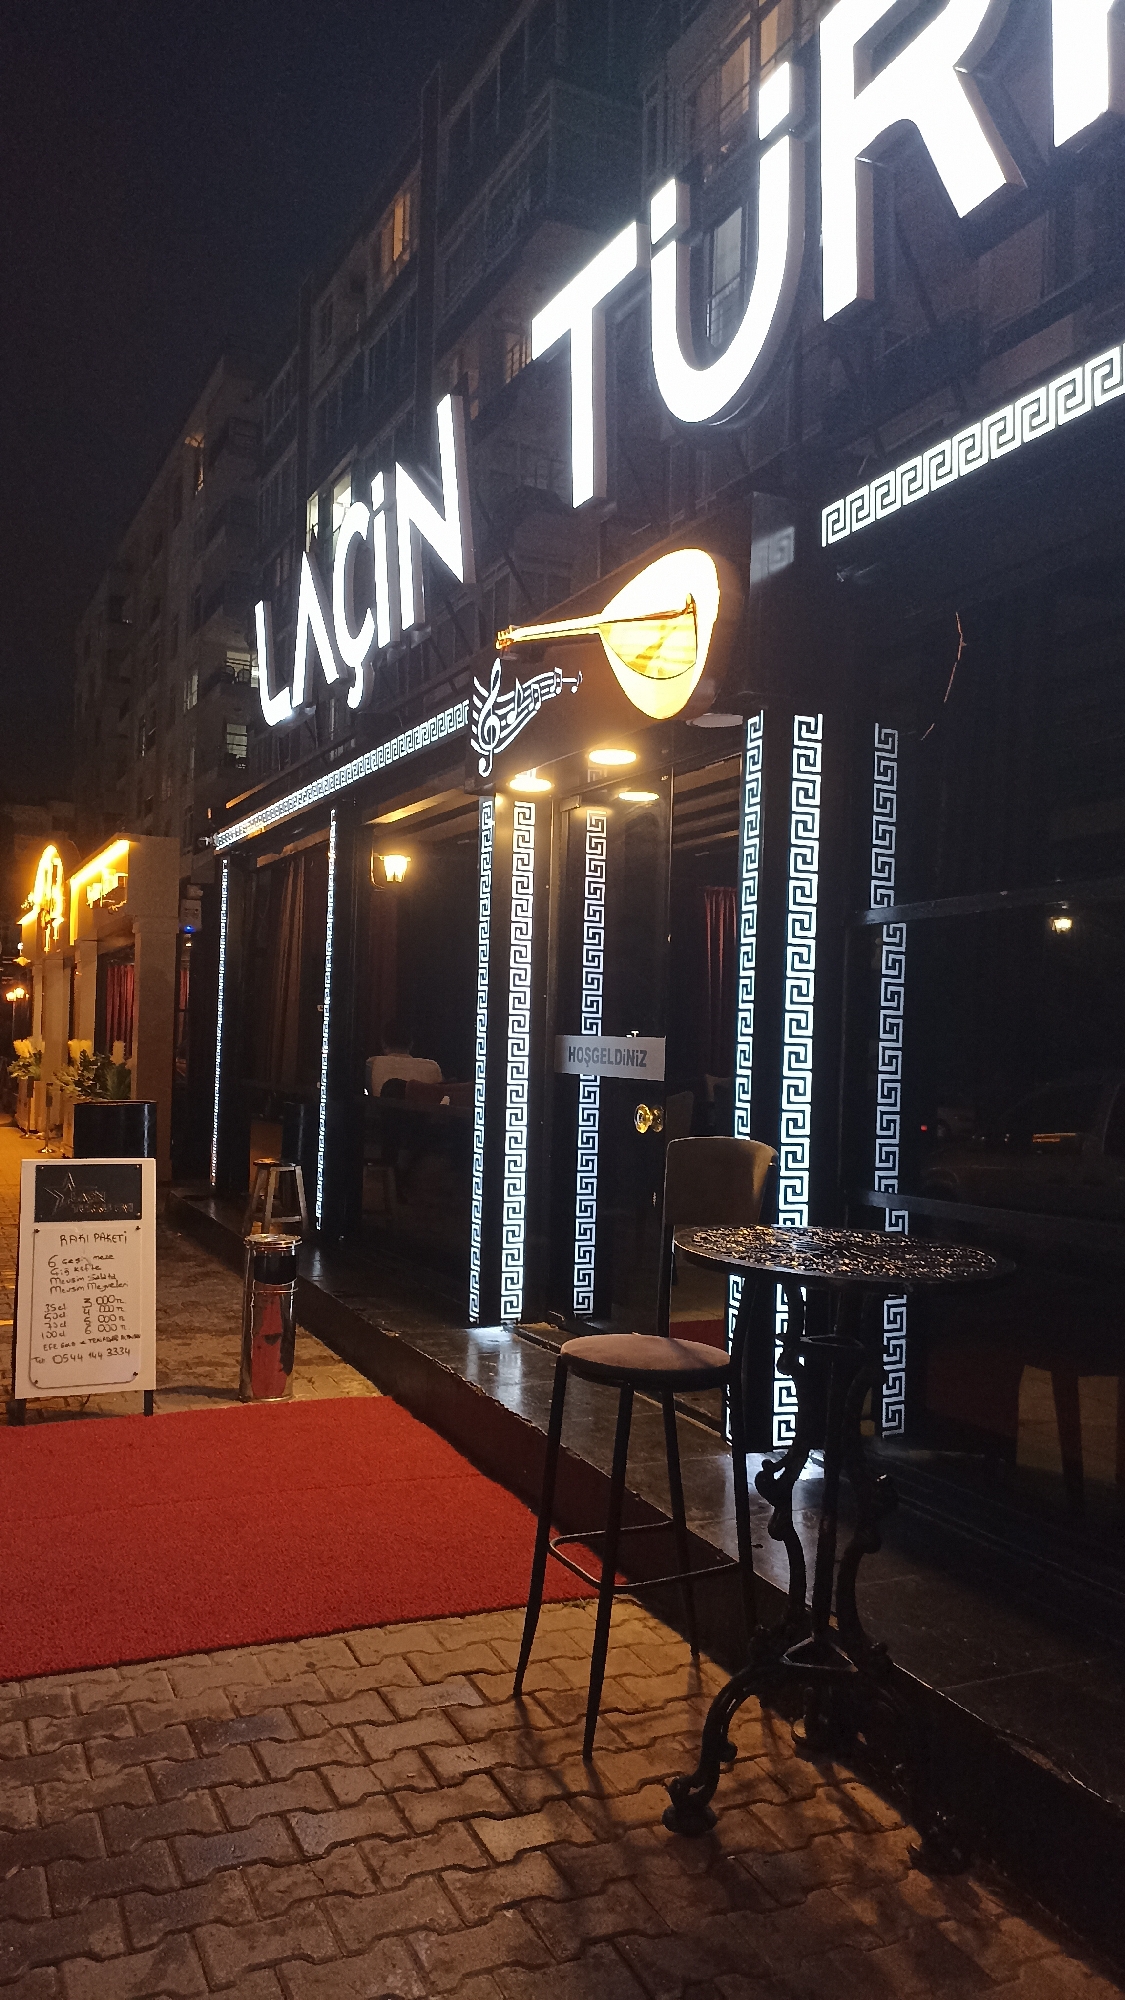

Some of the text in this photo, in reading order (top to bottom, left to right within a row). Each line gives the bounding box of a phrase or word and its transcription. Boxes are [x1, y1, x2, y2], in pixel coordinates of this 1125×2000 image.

[568, 1046, 647, 1068] HOŞGELDİNİZ
[59, 1231, 127, 1247] RAKI PAKETİ
[52, 1354, 83, 1364] 0544
